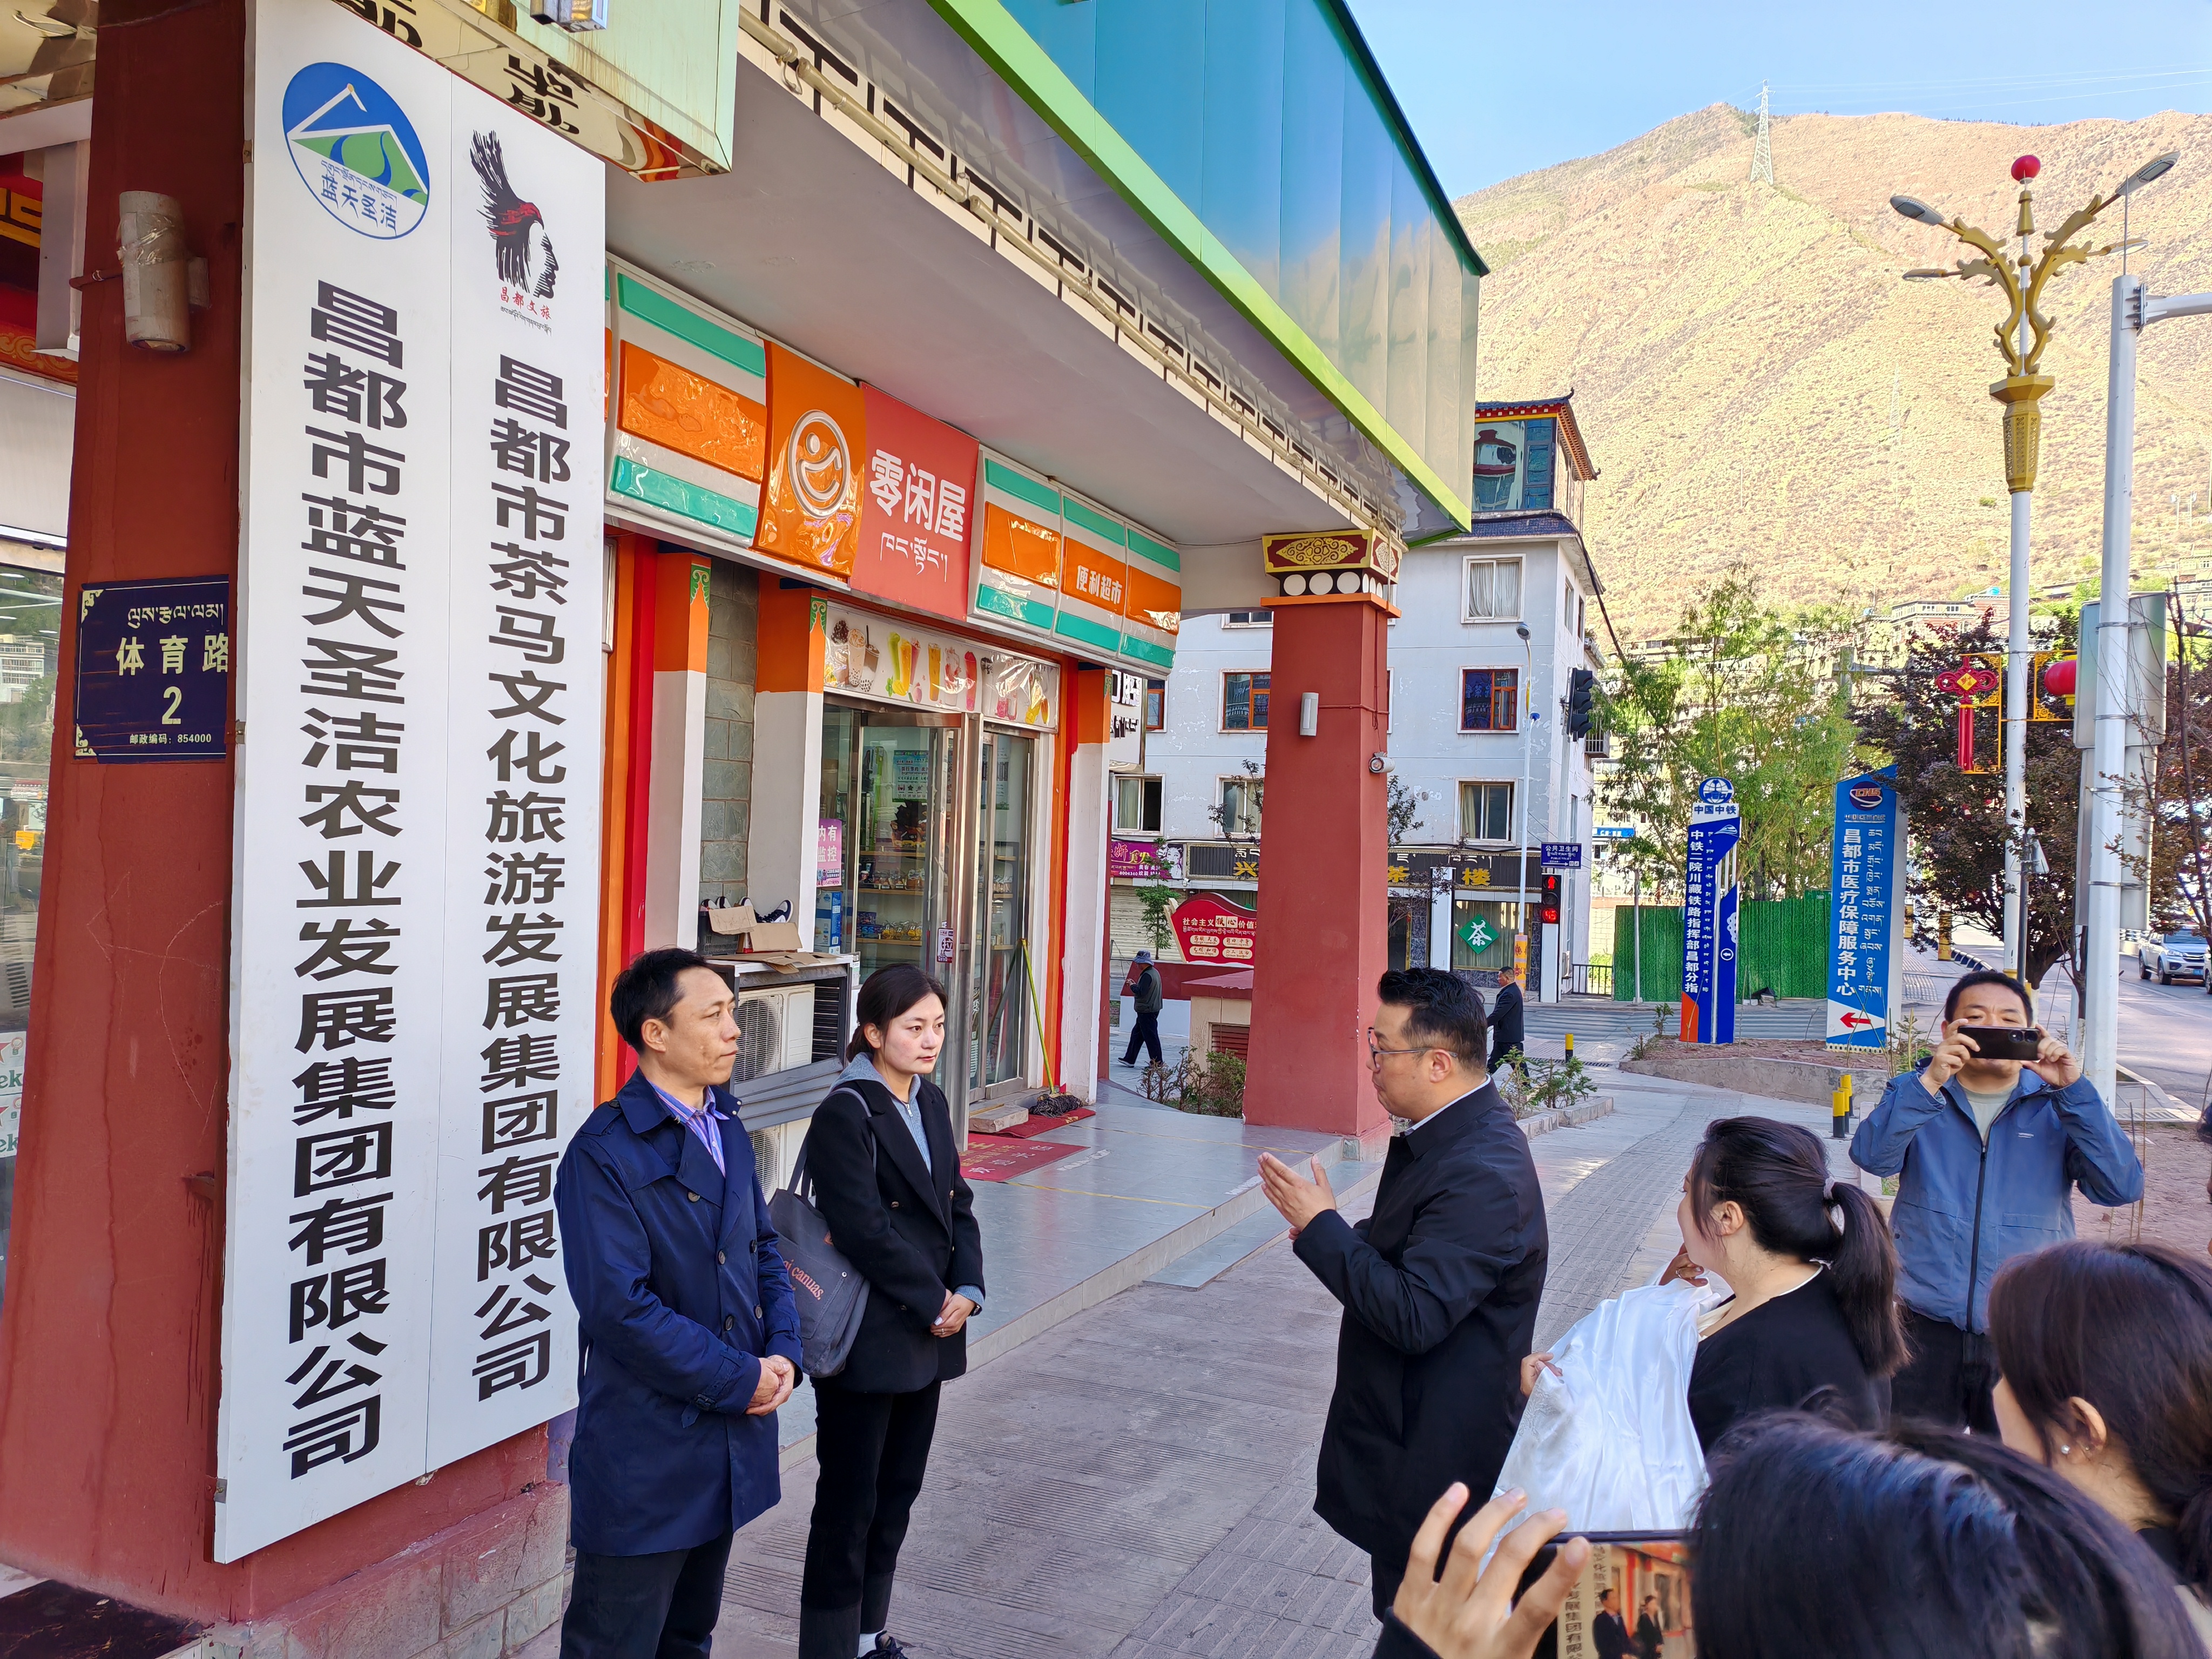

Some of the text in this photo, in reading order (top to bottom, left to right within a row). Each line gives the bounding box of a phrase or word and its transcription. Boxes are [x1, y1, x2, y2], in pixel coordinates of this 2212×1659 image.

[321, 174, 397, 231] 蓝天圣洁
[500, 286, 551, 320] 昌都文旅
[870, 449, 965, 542] 零闲屋
[1076, 565, 1123, 604] 便利超市
[116, 633, 228, 676] 体育路
[161, 686, 182, 724] 2
[1694, 805, 1737, 815] 中国中铁
[819, 825, 838, 842] 内有
[818, 845, 838, 862] 监控
[283, 279, 407, 1480] 昌都市蓝天圣洁农业发展集团有限公司
[471, 354, 571, 1402] 昌都市茶马文化旅游发展集团有限公司
[1183, 915, 1257, 929] 社会主义核心价值
[1684, 830, 1704, 994] 中铁二院川藏铁路指挥部昌都分指
[1836, 828, 1862, 996] 昌都市医疗保障服务中心
[1467, 920, 1492, 946] 茶
